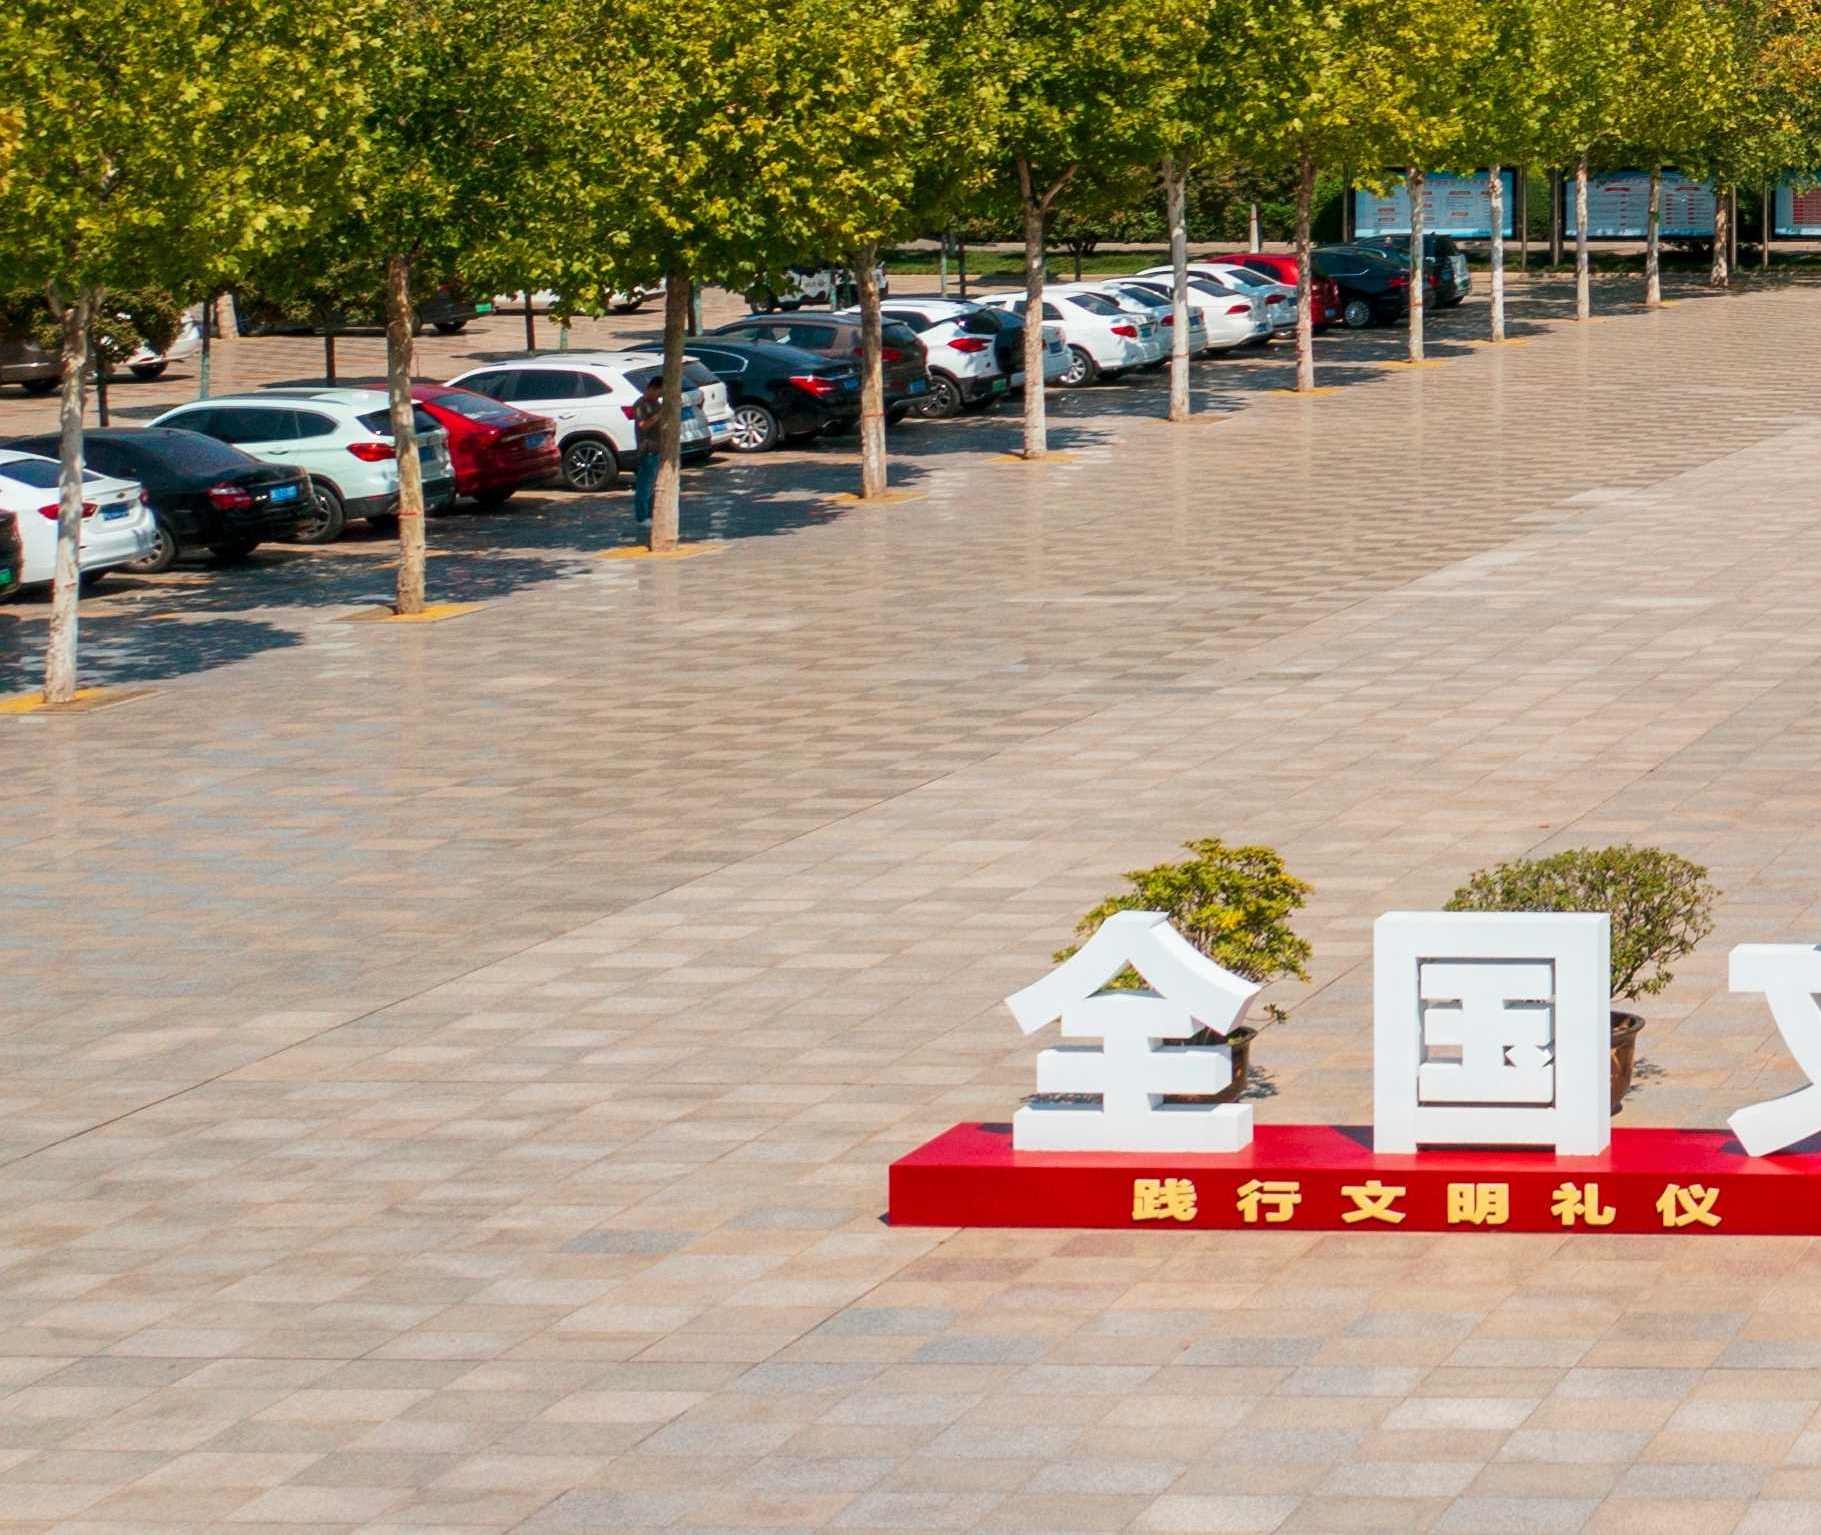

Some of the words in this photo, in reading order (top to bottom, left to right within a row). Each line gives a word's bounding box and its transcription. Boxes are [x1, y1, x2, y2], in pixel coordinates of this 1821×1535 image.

[1131, 1178, 1722, 1228] 践行文明礼仪
